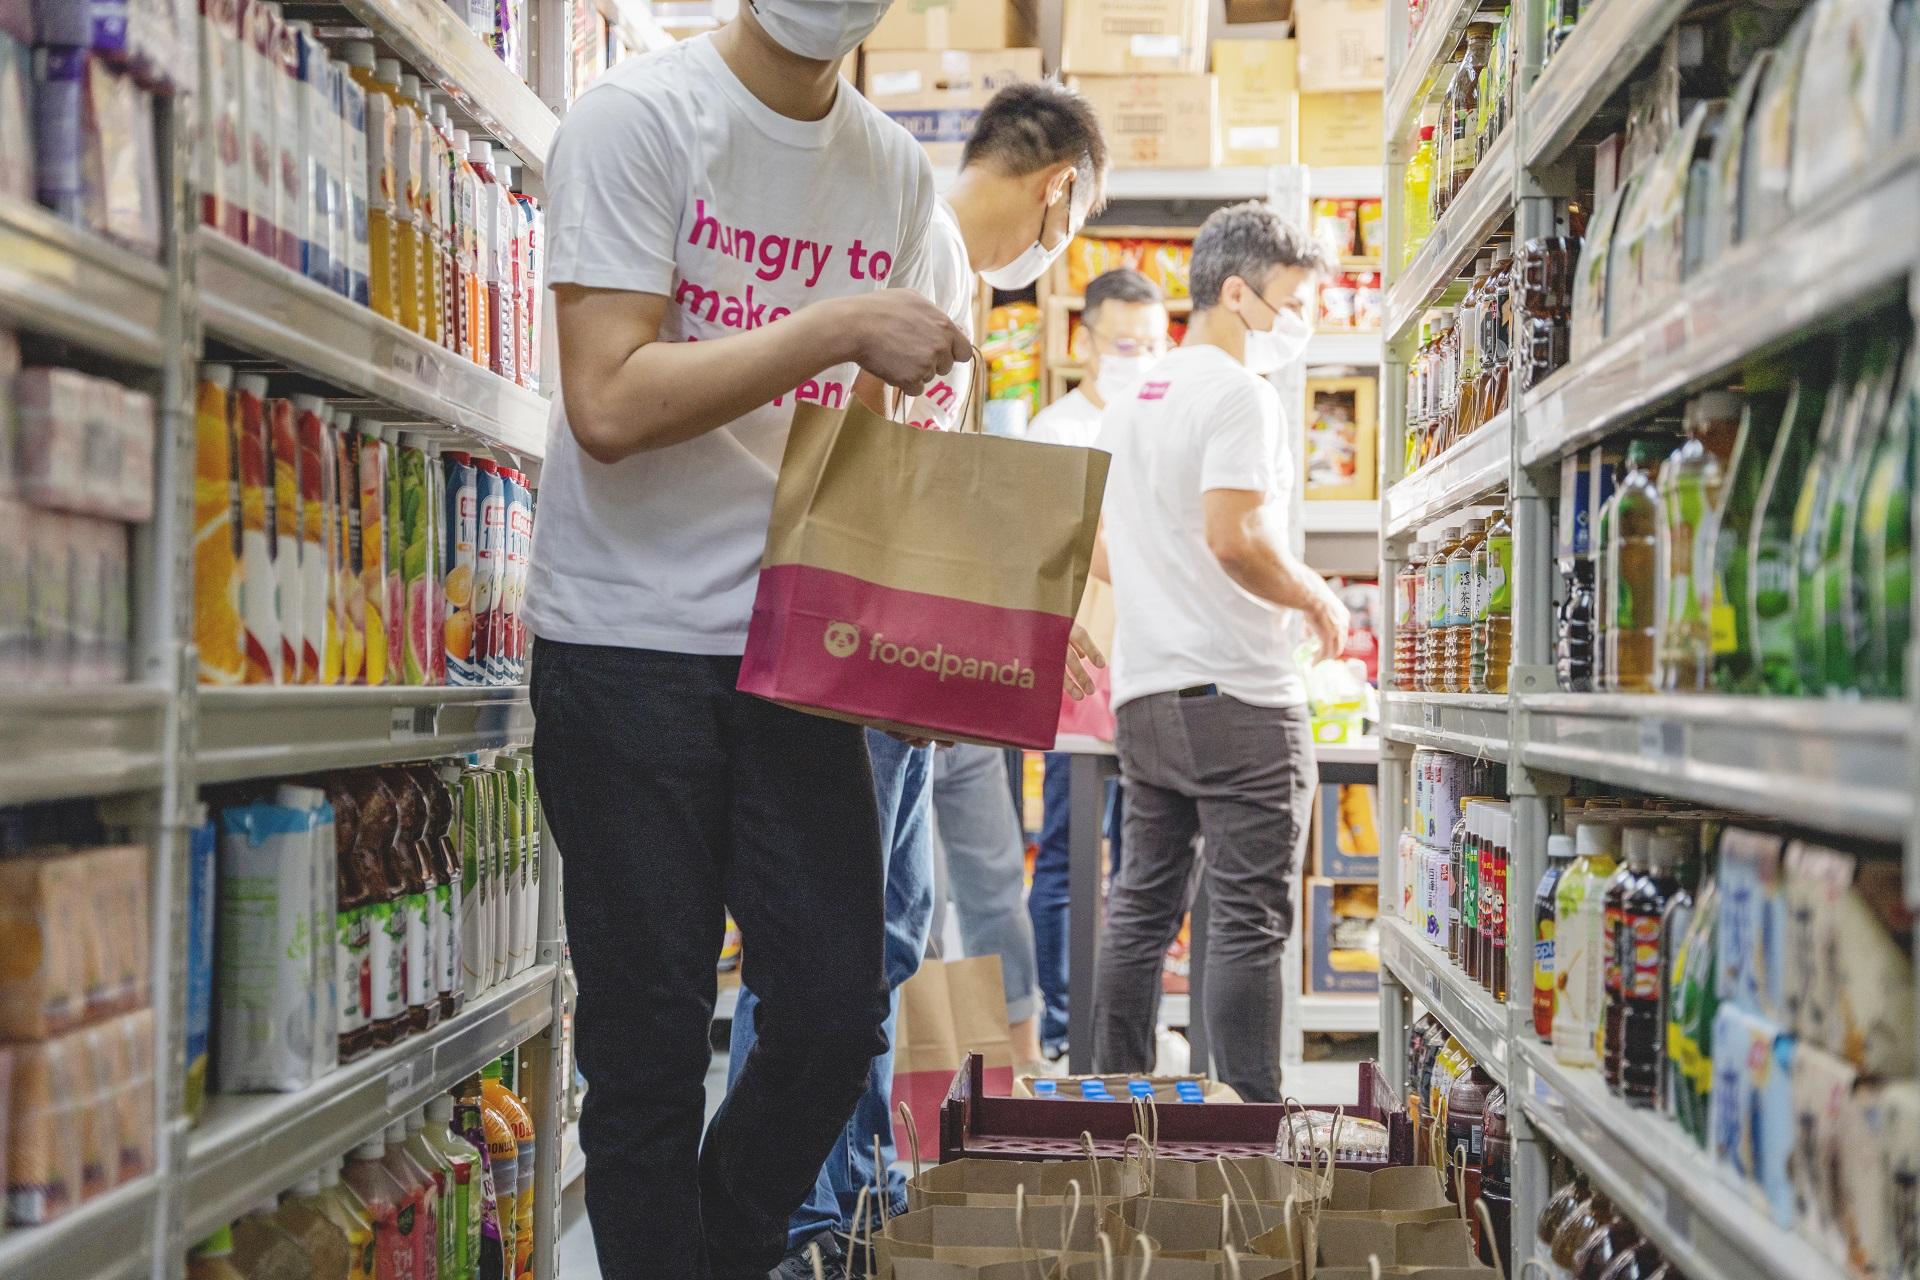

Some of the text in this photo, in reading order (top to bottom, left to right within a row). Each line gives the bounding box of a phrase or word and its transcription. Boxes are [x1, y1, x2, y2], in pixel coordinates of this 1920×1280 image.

[687, 198, 892, 288] hungry to
[868, 632, 1036, 689] foodpanda
